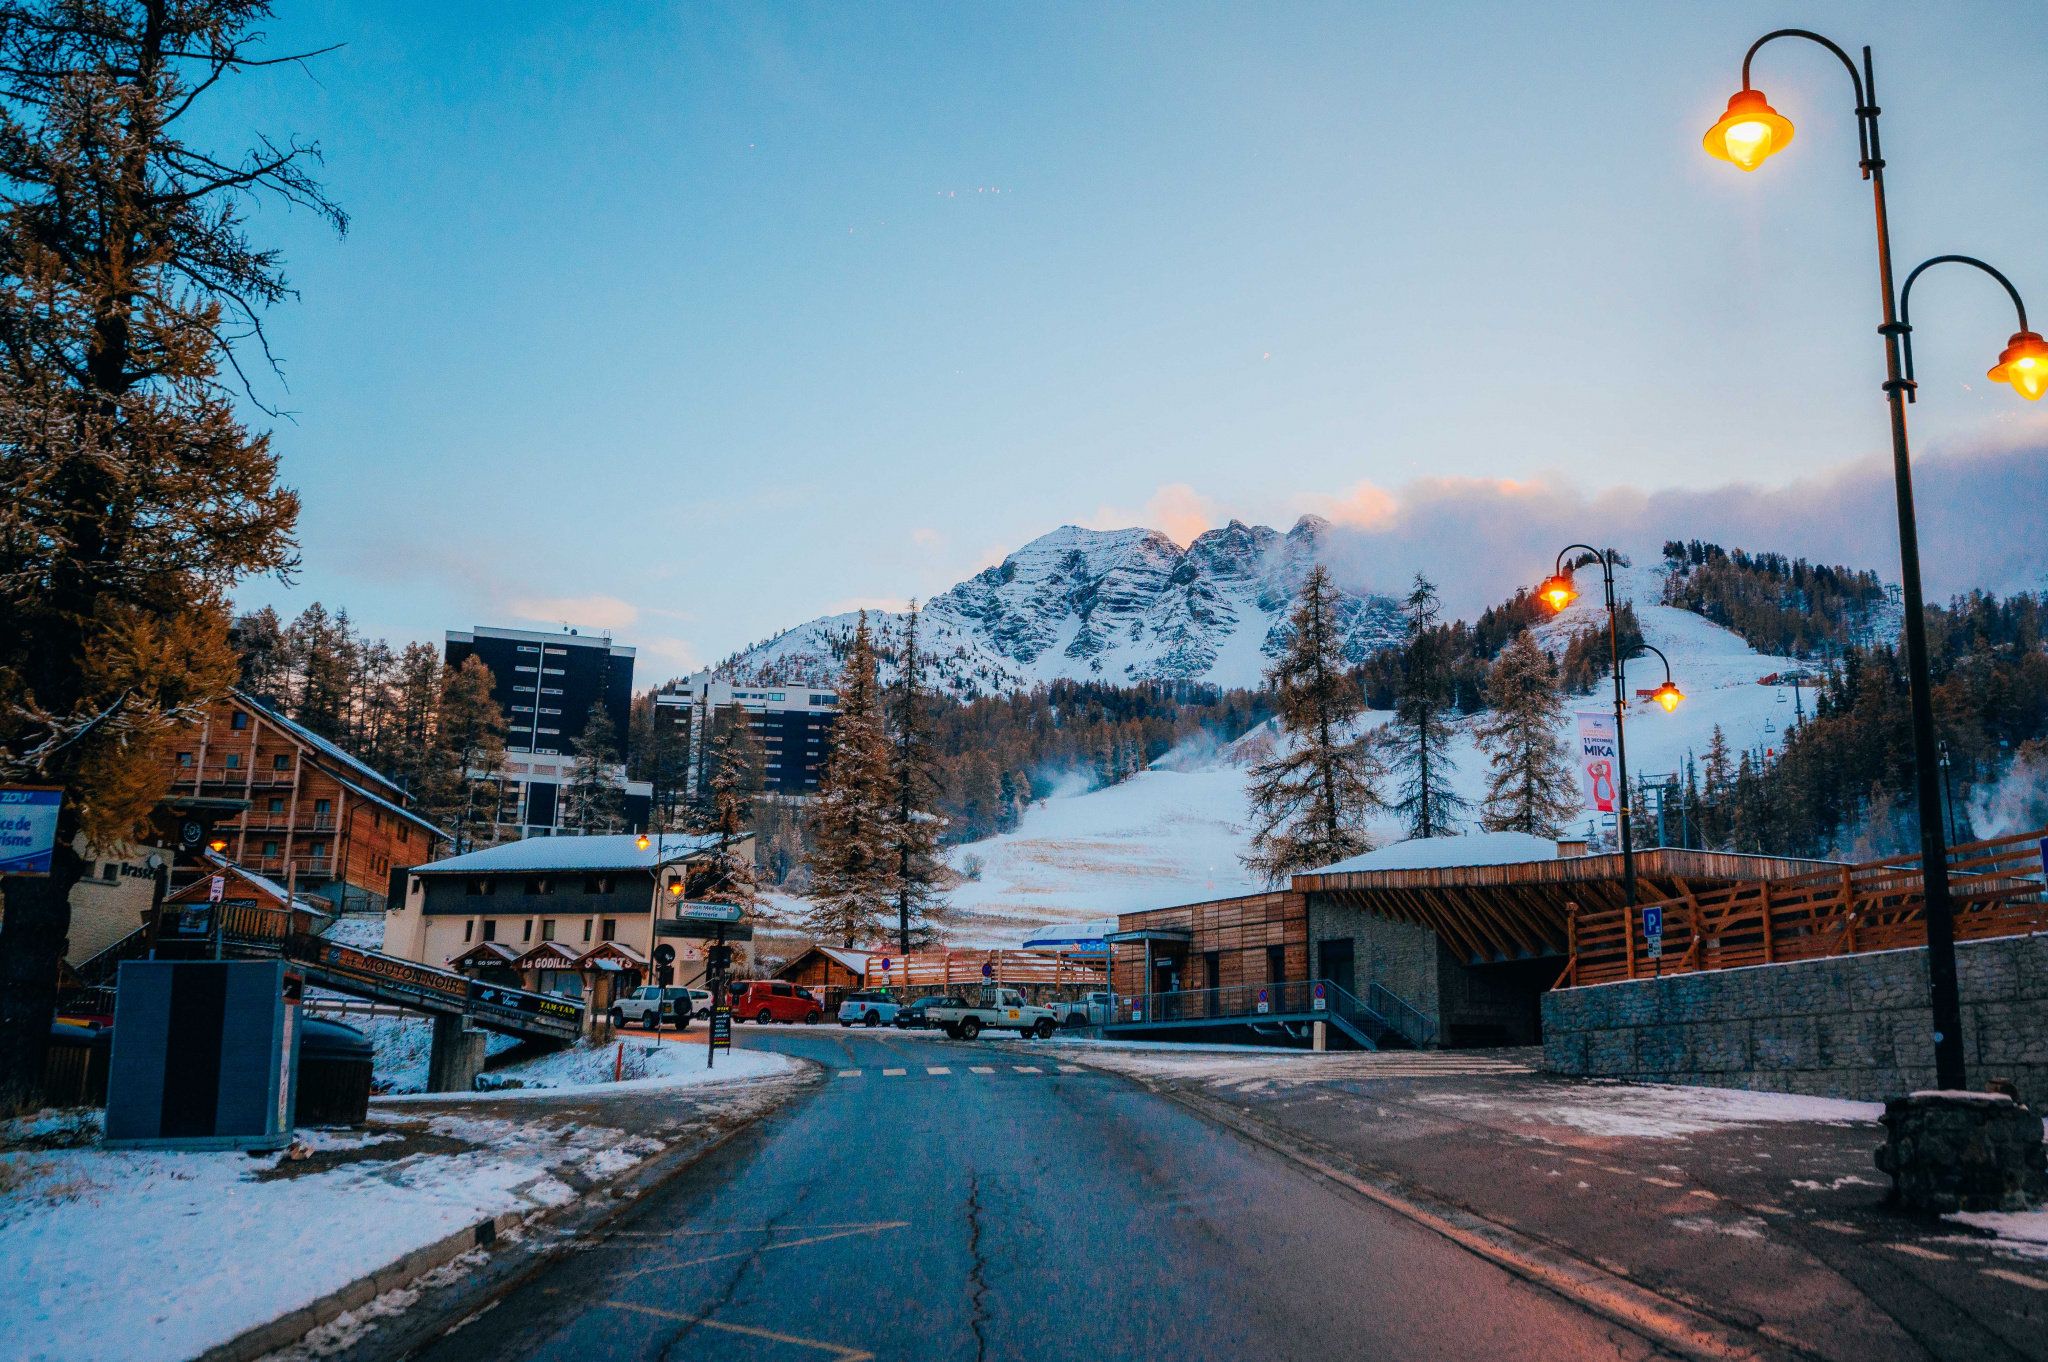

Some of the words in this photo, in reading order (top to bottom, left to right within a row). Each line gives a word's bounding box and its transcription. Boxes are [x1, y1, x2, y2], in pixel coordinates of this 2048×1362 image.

[1584, 745, 1614, 757] MIKA
[15, 816, 31, 831] de
[1648, 914, 1656, 931] P
[522, 958, 532, 968] La
[535, 958, 572, 968] GODILLE
[345, 956, 358, 967] LE
[361, 958, 422, 982] MOUTON
[424, 971, 459, 992] NOIR
